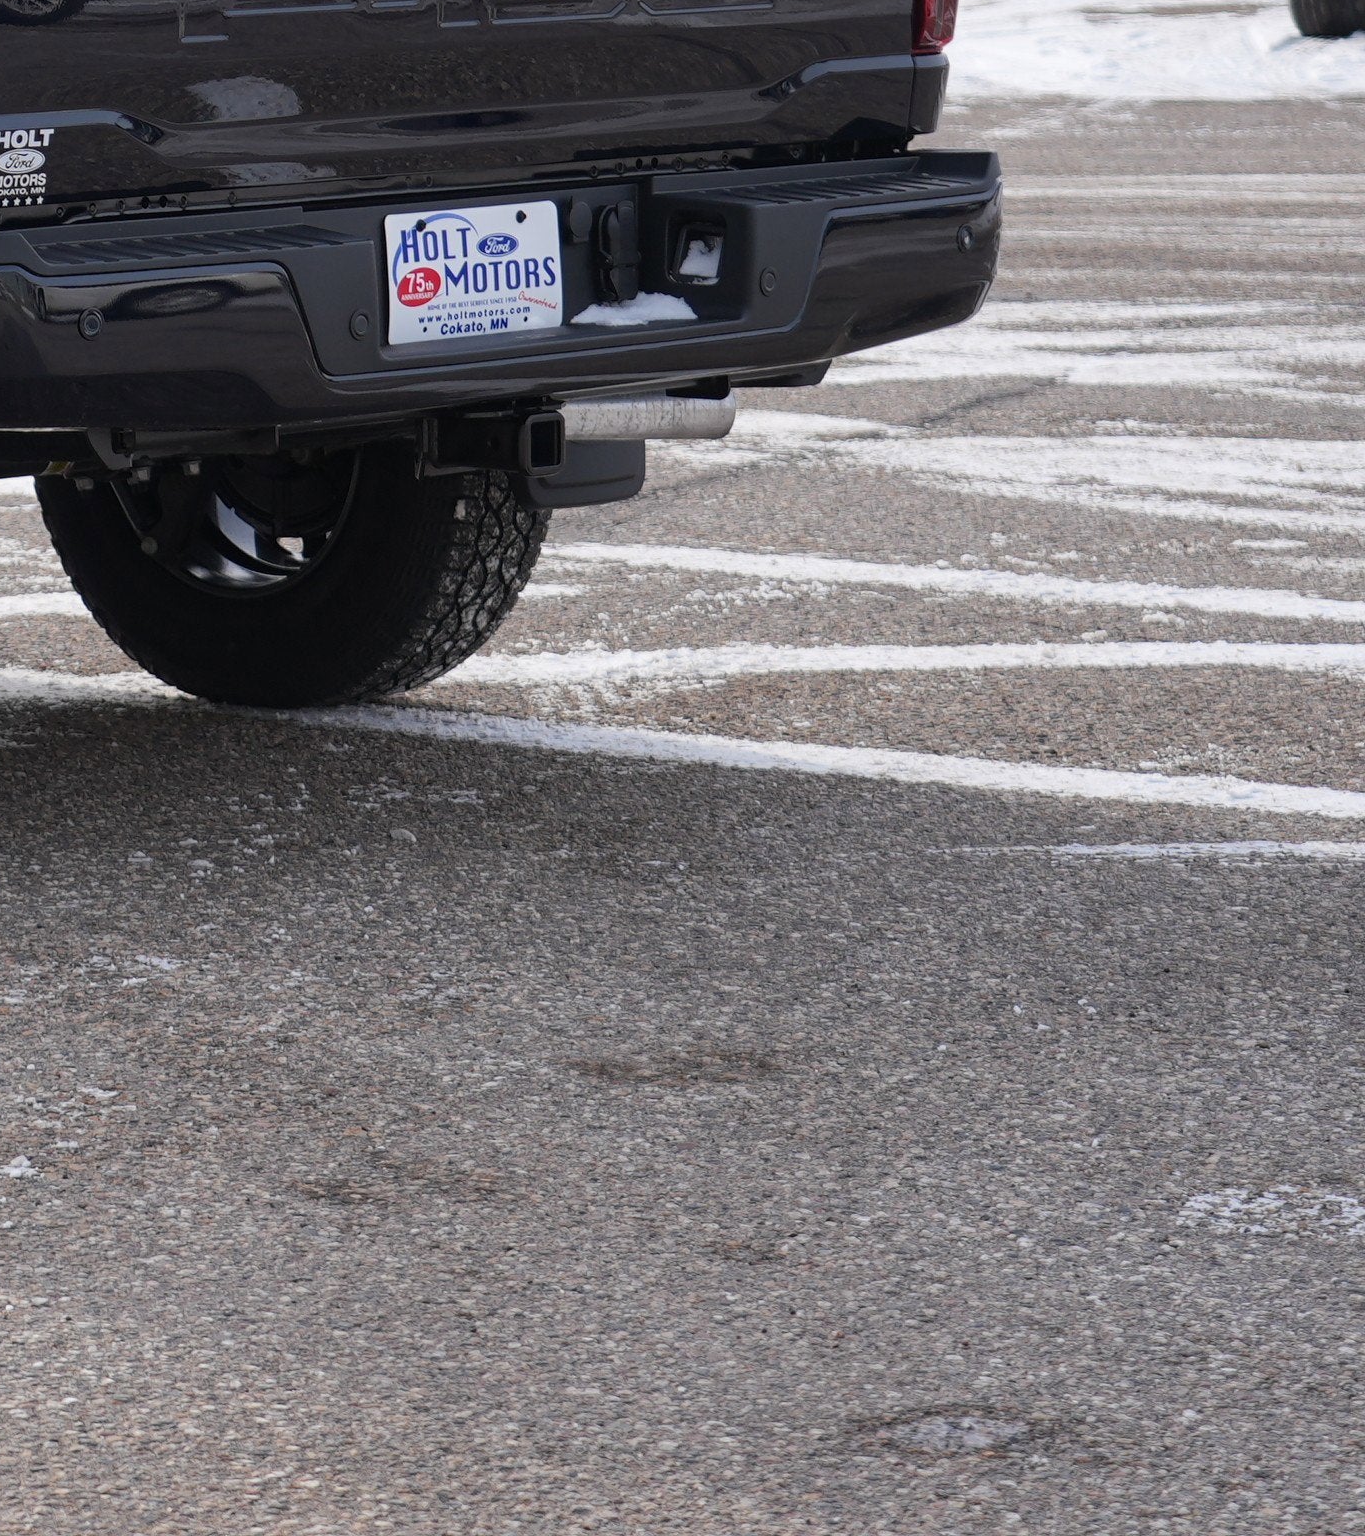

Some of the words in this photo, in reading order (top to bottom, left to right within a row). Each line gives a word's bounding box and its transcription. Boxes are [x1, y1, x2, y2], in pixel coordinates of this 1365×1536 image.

[5, 153, 36, 169] Ford
[30, 186, 46, 194] MN
[400, 227, 471, 264] HOLT
[484, 236, 511, 254] Ford
[406, 272, 435, 294] 75th
[444, 256, 556, 296] MOTORS
[401, 291, 434, 302] ANNIVERSARY
[418, 305, 531, 324] www.holtmotors.com
[440, 321, 486, 335] Cokato,
[490, 317, 509, 330] MN
